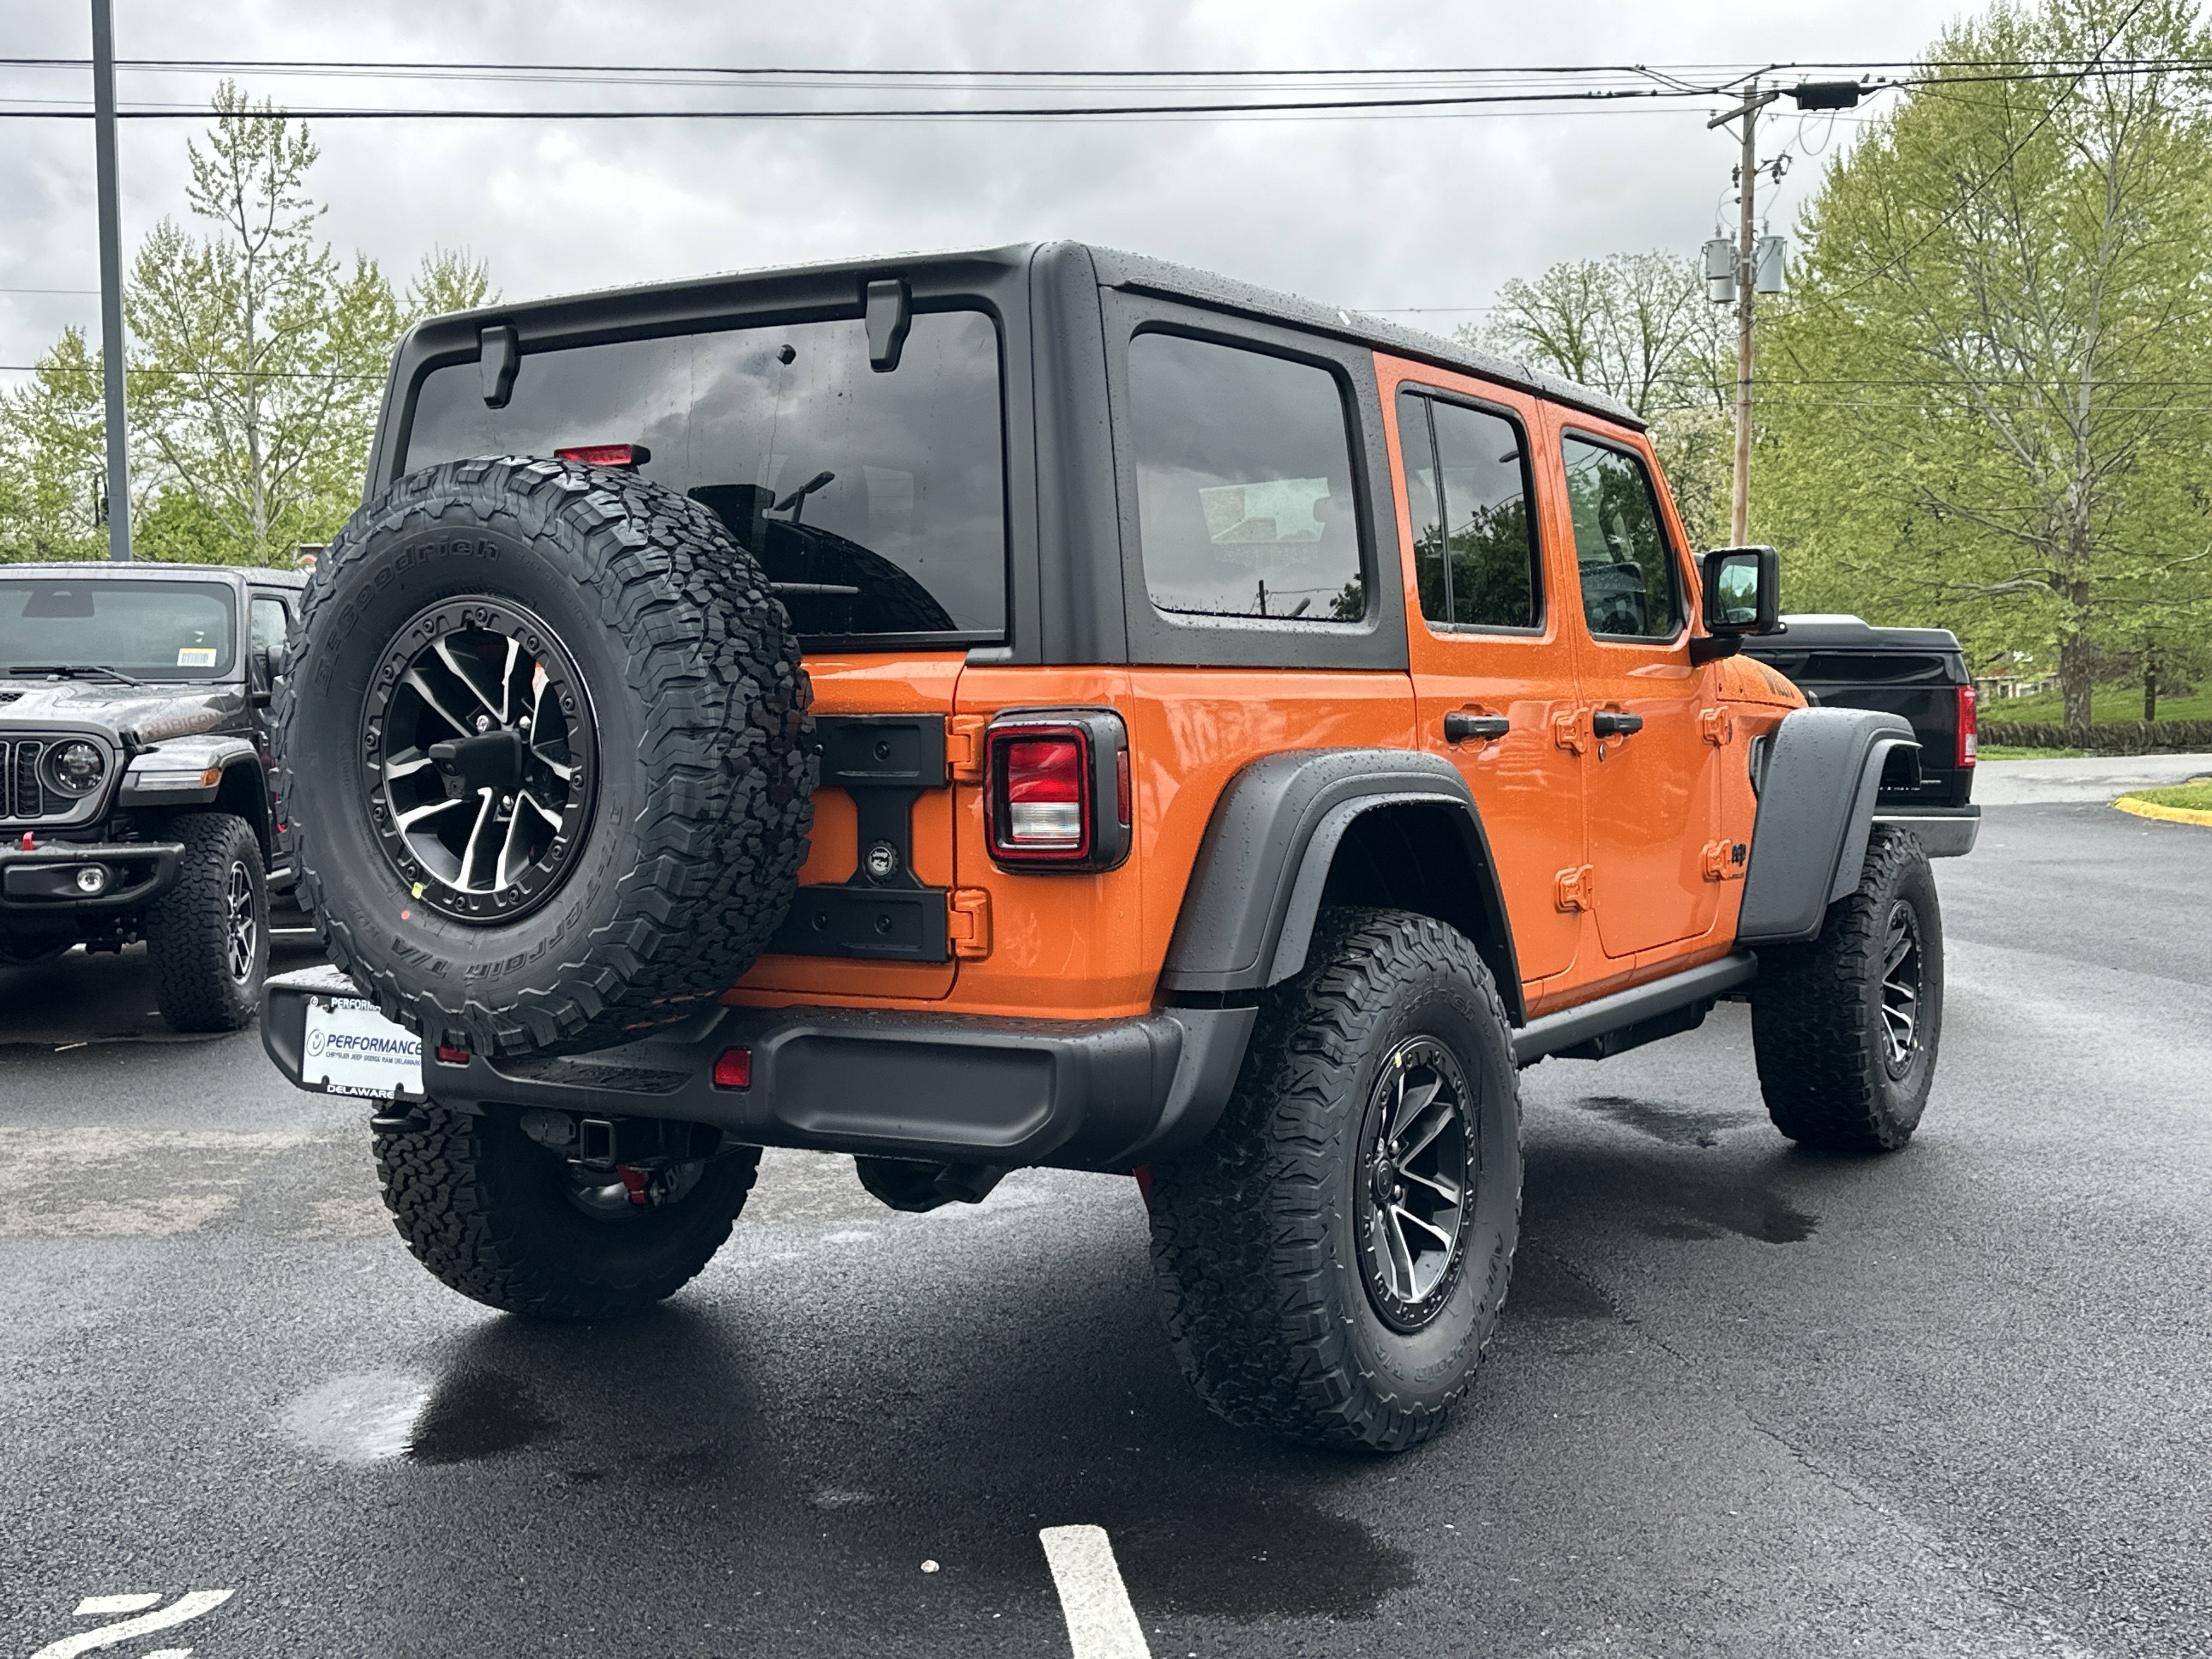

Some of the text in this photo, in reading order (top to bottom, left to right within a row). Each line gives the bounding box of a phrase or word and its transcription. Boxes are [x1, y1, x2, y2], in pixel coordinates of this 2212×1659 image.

[315, 534, 500, 697] BFGoodrich
[139, 712, 221, 737] RUBICON
[326, 1034, 422, 1056] PERFORMANCE
[326, 1085, 395, 1099] DELAWARE
